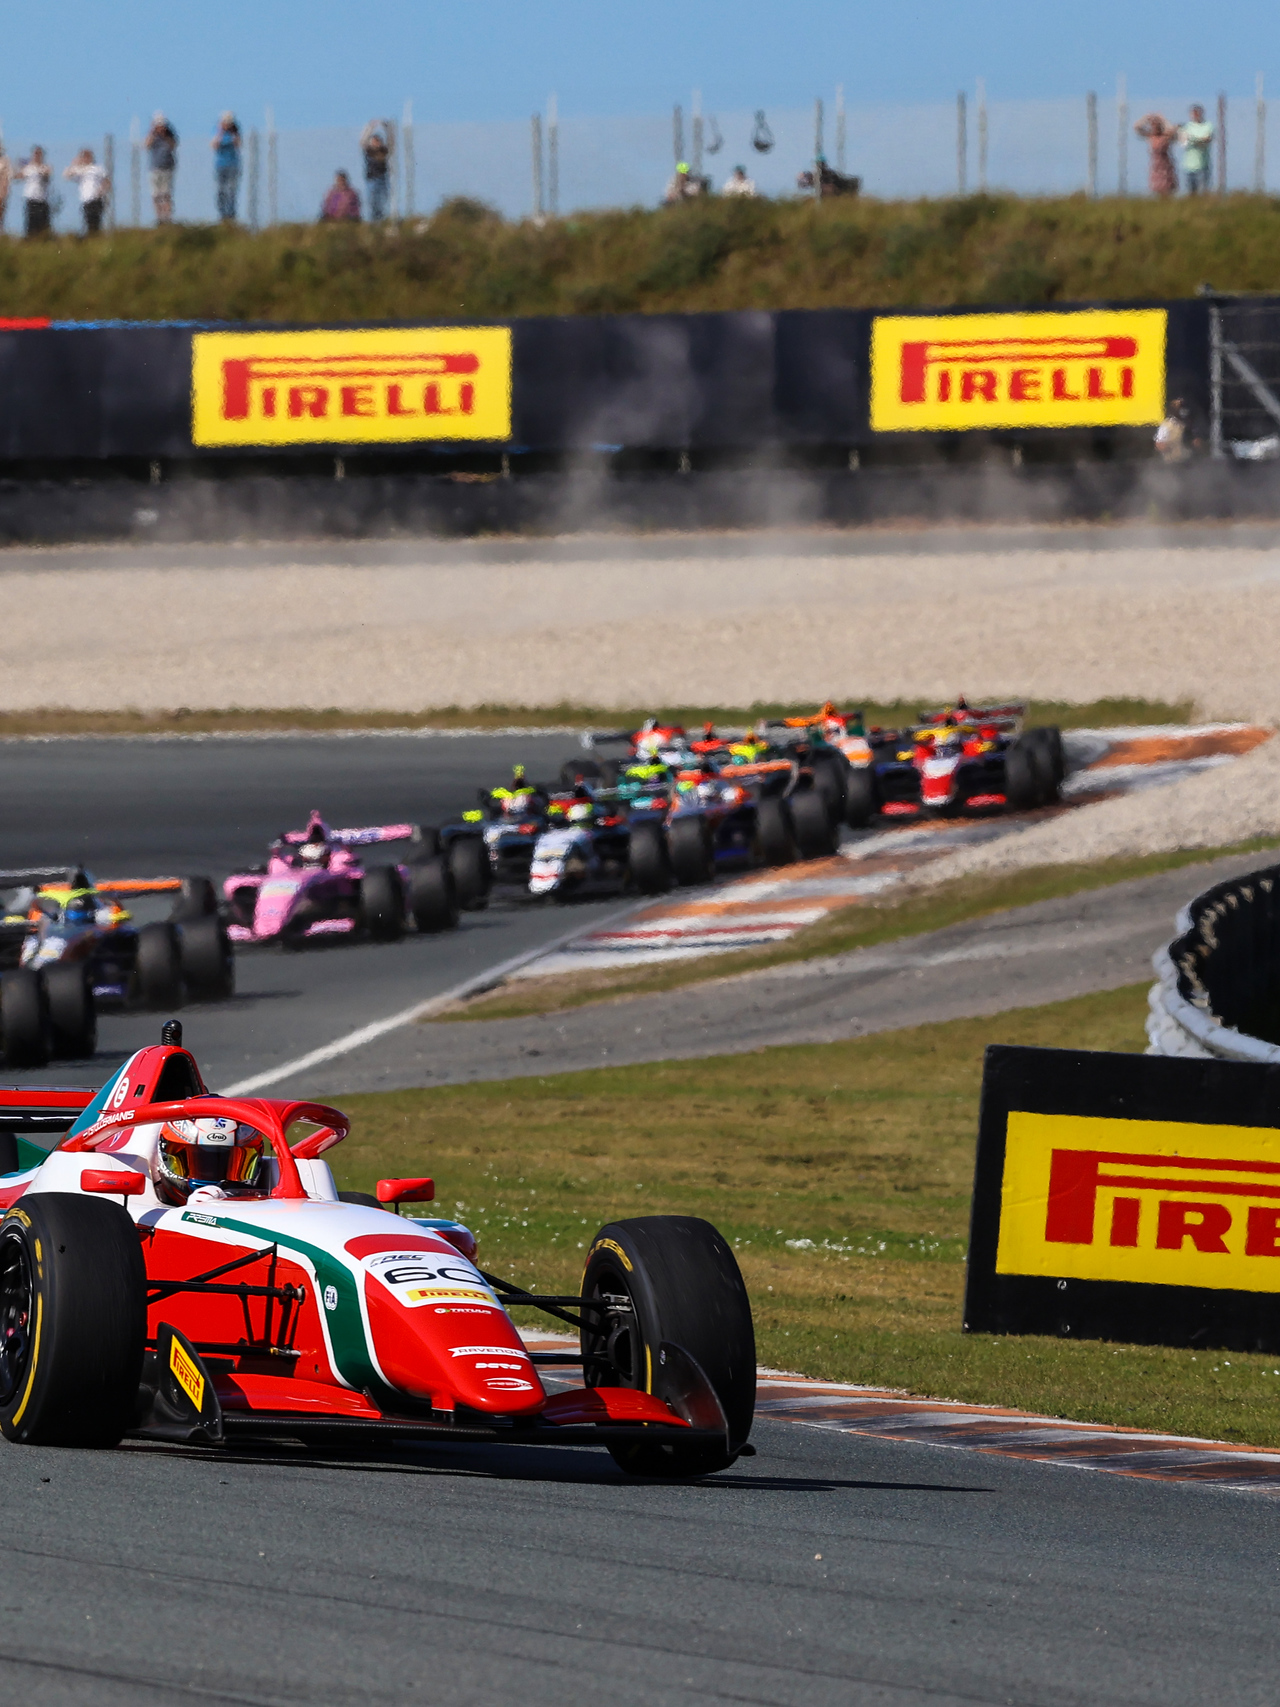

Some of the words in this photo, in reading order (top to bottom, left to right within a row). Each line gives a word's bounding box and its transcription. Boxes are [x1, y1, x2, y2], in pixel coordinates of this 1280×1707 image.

[900, 336, 1138, 403] PIRELLI
[222, 353, 479, 420] PIRELLI
[186, 1213, 217, 1226] PREMA
[384, 1266, 489, 1288] 60
[418, 1289, 489, 1300] PIRELLI
[458, 1347, 520, 1356] RAVENOL
[173, 1346, 201, 1402] PIRELLI
